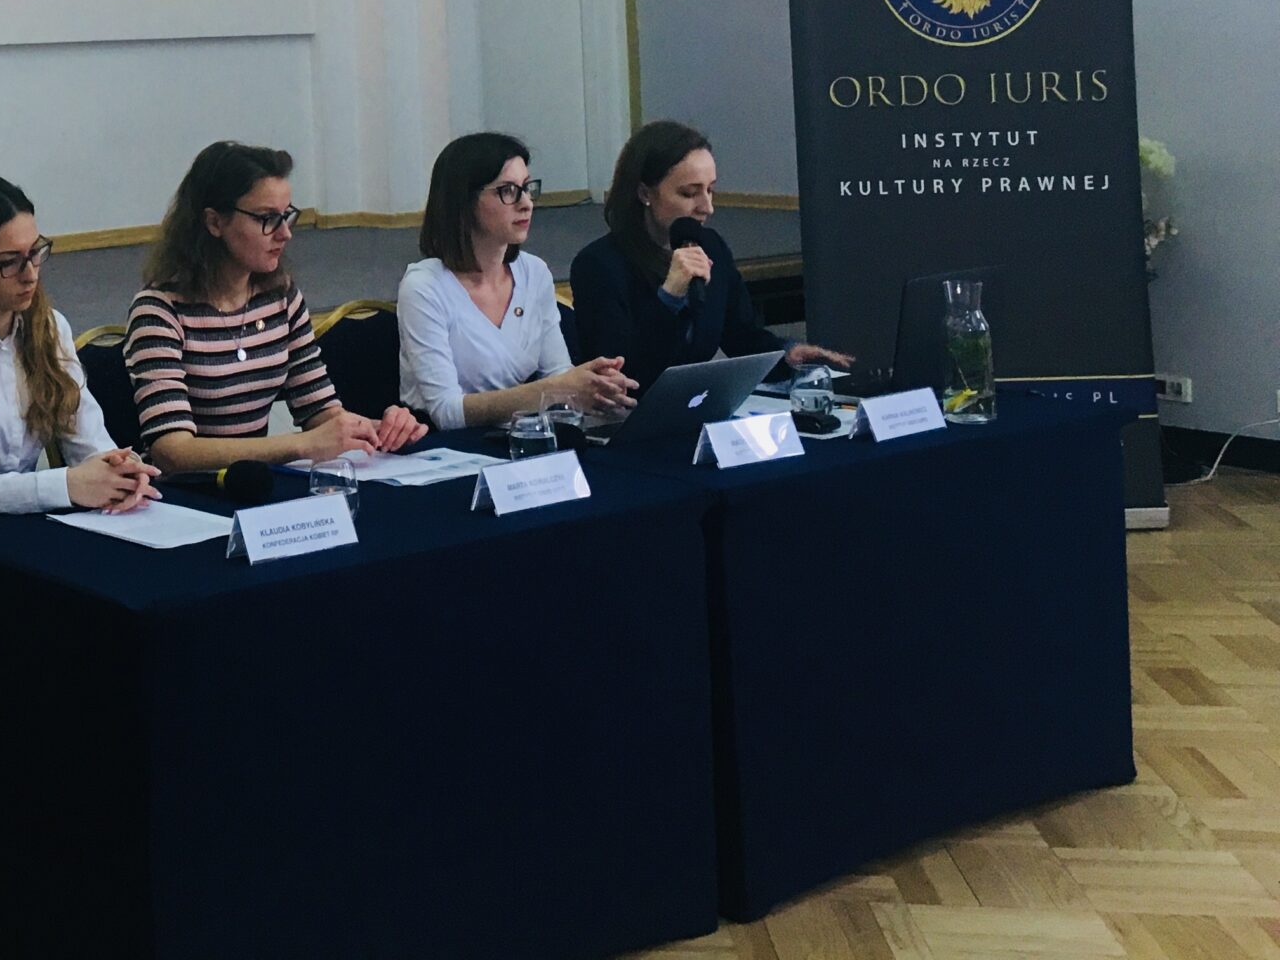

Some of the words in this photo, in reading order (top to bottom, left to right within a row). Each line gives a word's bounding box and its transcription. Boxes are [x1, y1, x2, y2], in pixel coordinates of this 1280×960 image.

[909, 13, 962, 40] ORDO
[972, 12, 1019, 39] IURIS
[829, 73, 966, 108] ORDO
[990, 70, 1108, 104] IURIS
[901, 130, 1038, 149] INSTYTUT
[932, 158, 952, 168] NA
[962, 157, 1011, 168] RZECZ
[840, 178, 963, 196] KULTURY
[982, 175, 1110, 193] PRAWNEJ
[260, 525, 290, 537] KLAUDIA
